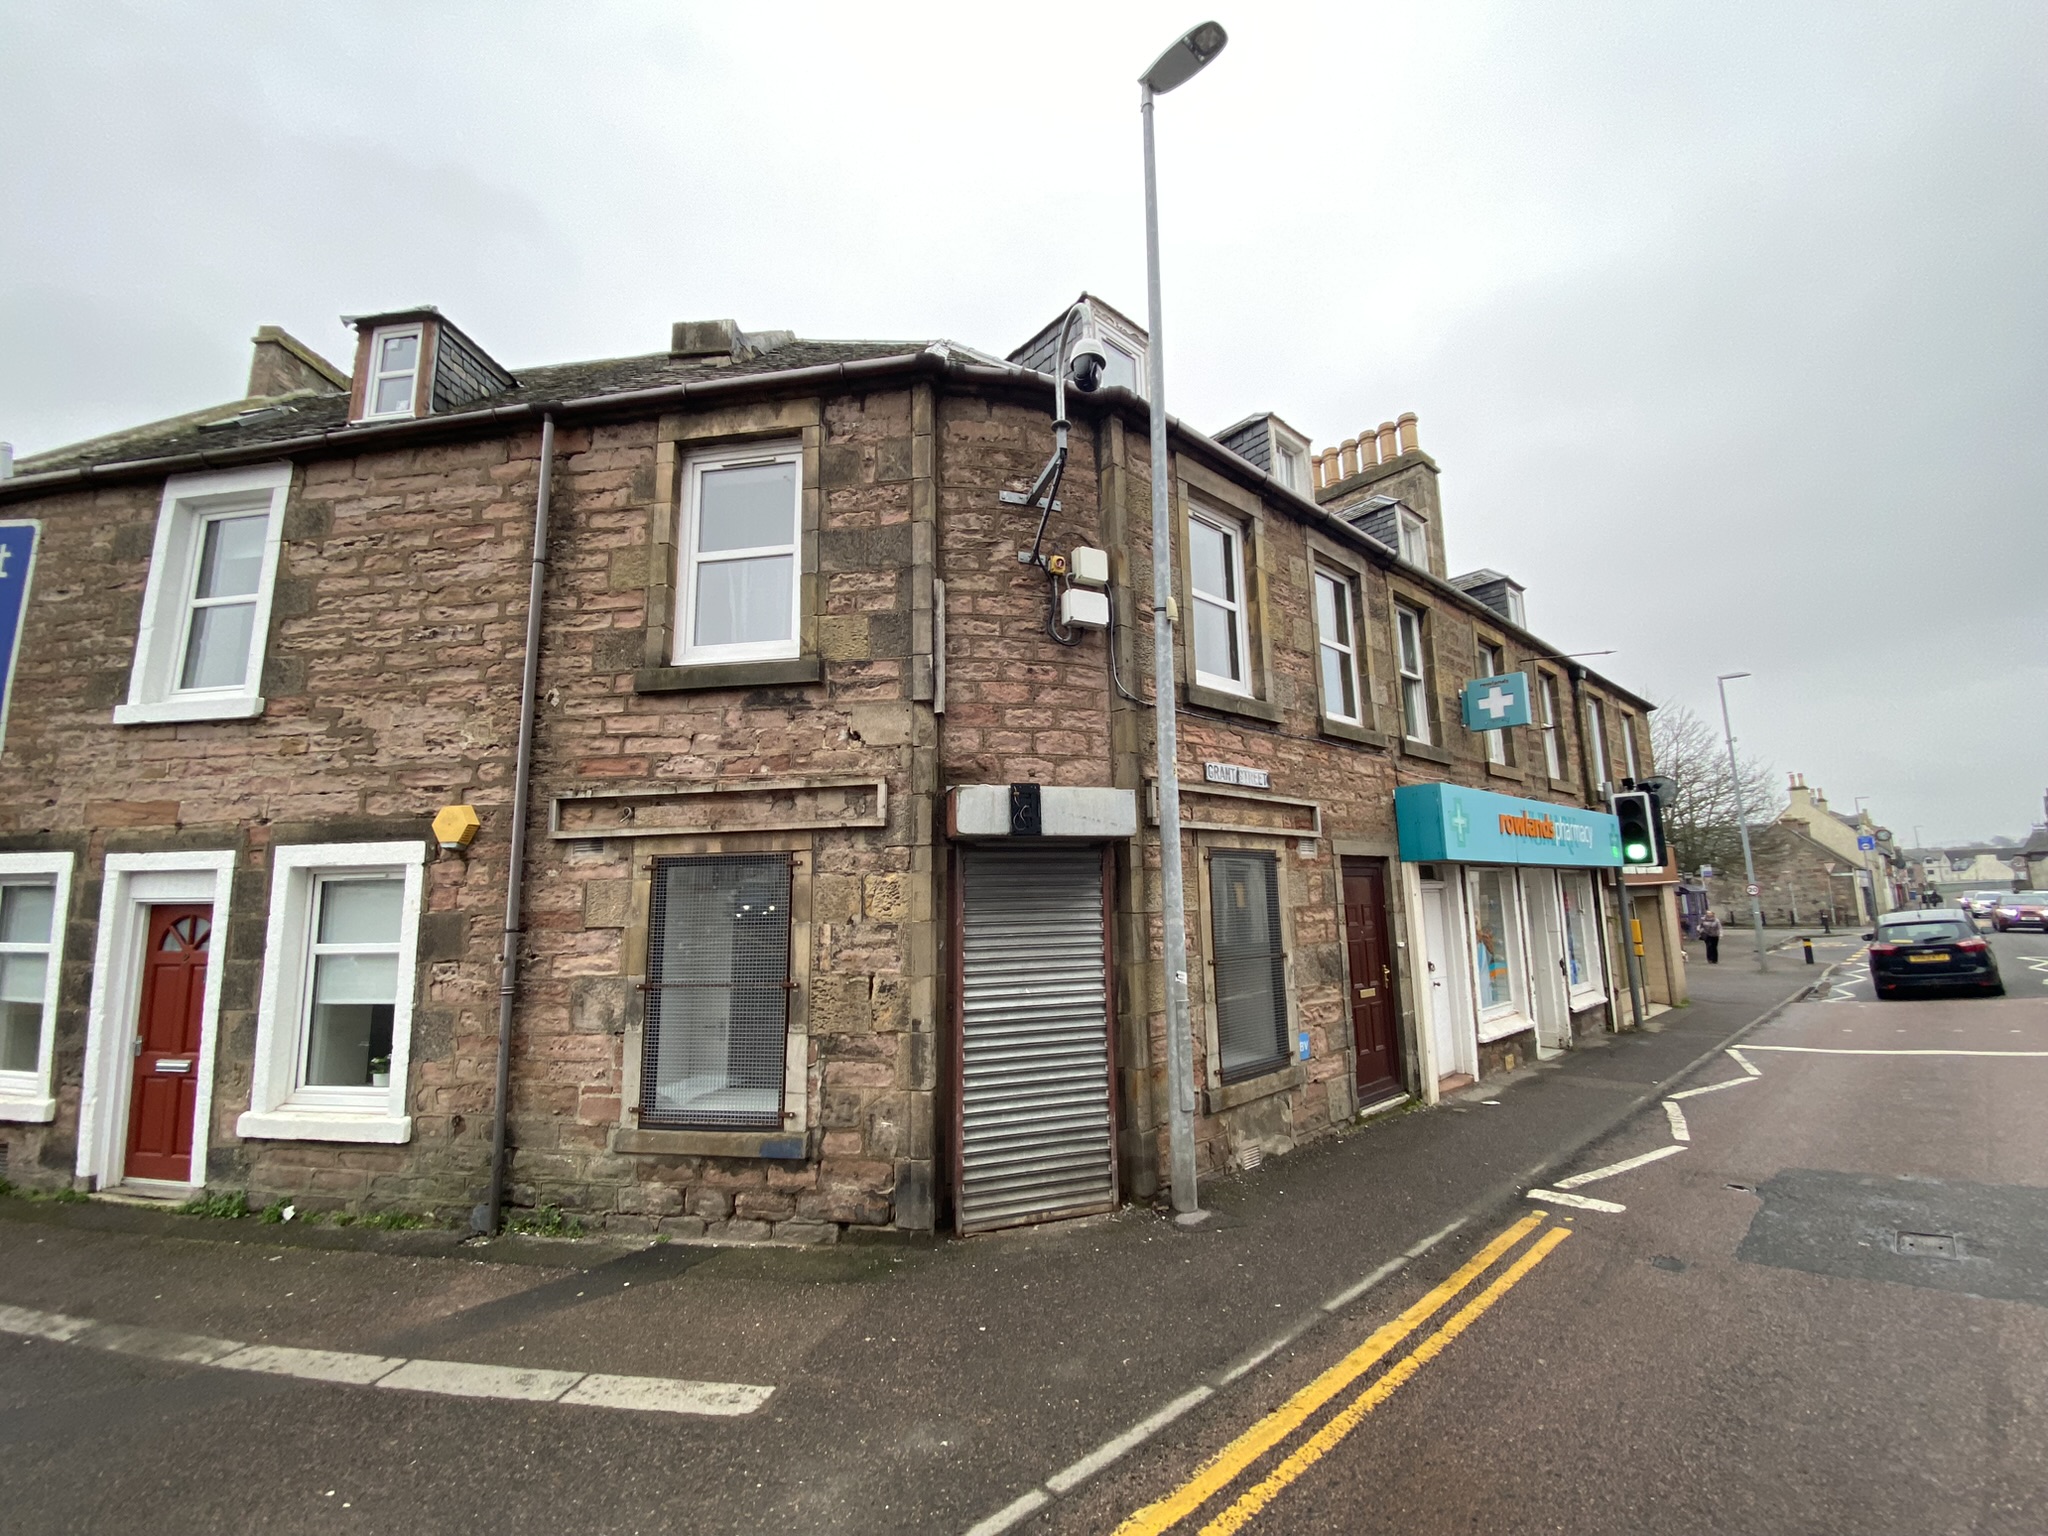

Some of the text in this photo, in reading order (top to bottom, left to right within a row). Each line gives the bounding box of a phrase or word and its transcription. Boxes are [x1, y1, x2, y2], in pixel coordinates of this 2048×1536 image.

[1207, 764, 1268, 786] GRANT STREET
[1498, 810, 1593, 849] rowlands pharmacy
